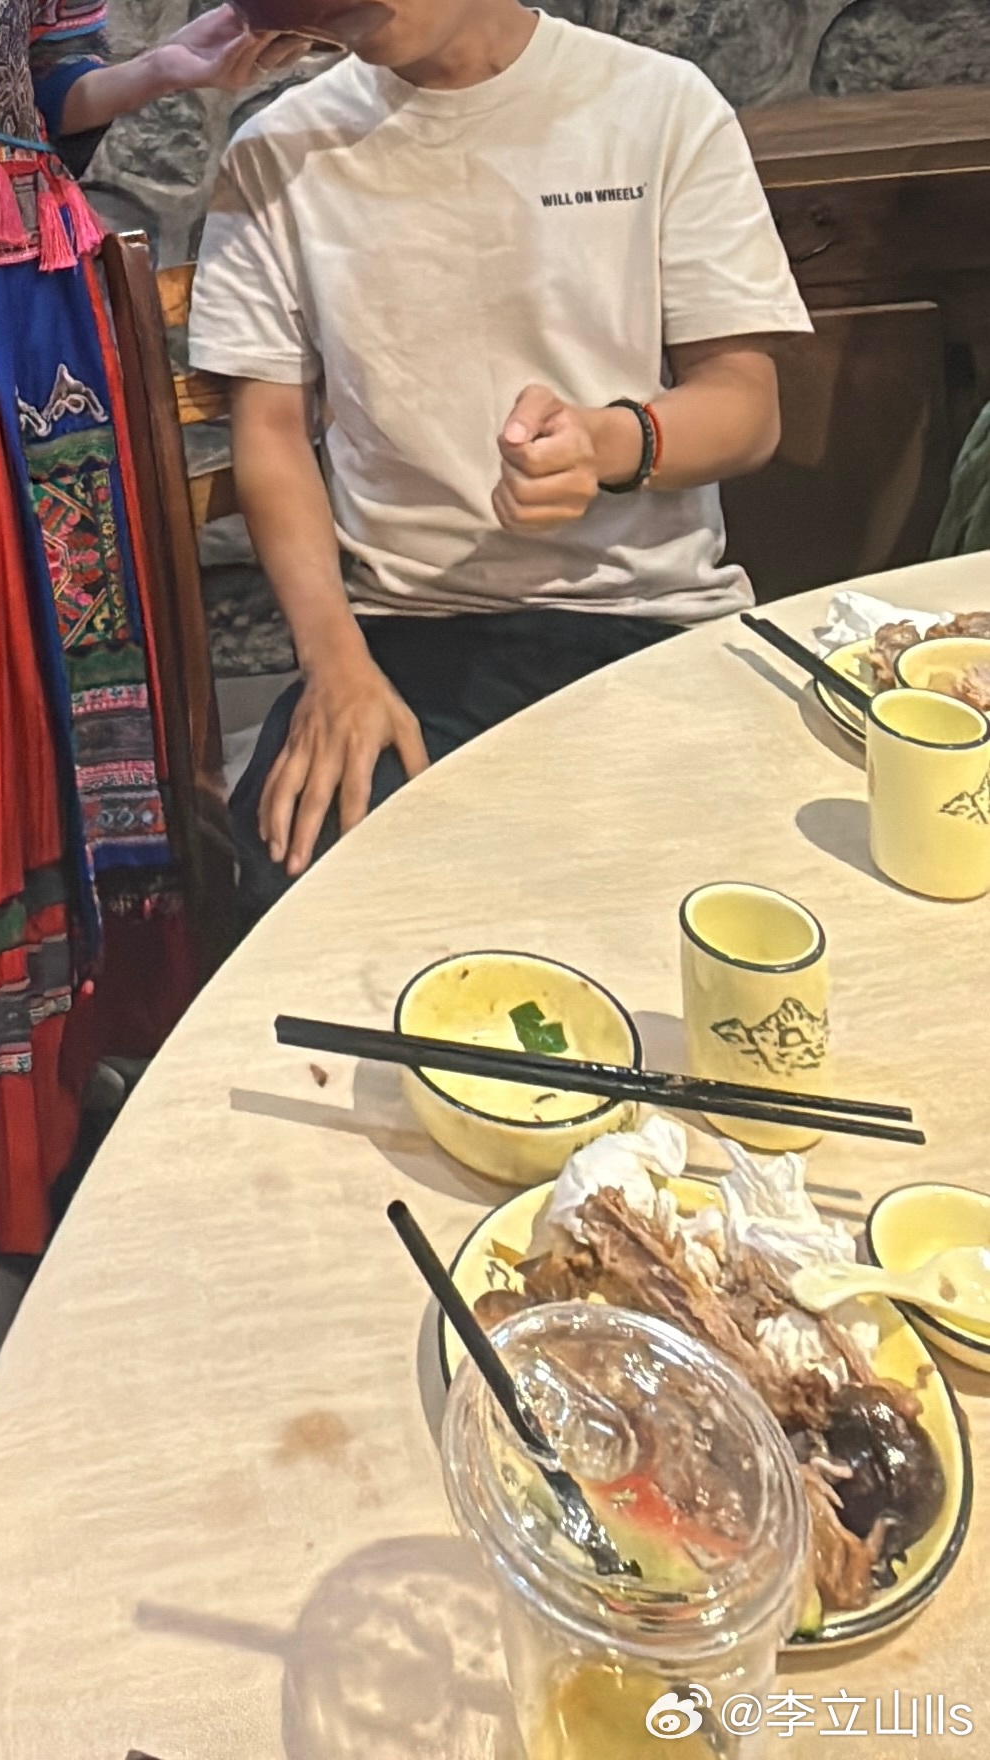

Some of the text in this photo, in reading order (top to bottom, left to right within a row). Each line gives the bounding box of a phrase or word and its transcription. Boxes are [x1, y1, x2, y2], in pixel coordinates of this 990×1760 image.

[541, 185, 645, 207] WILL ON WHEELS
